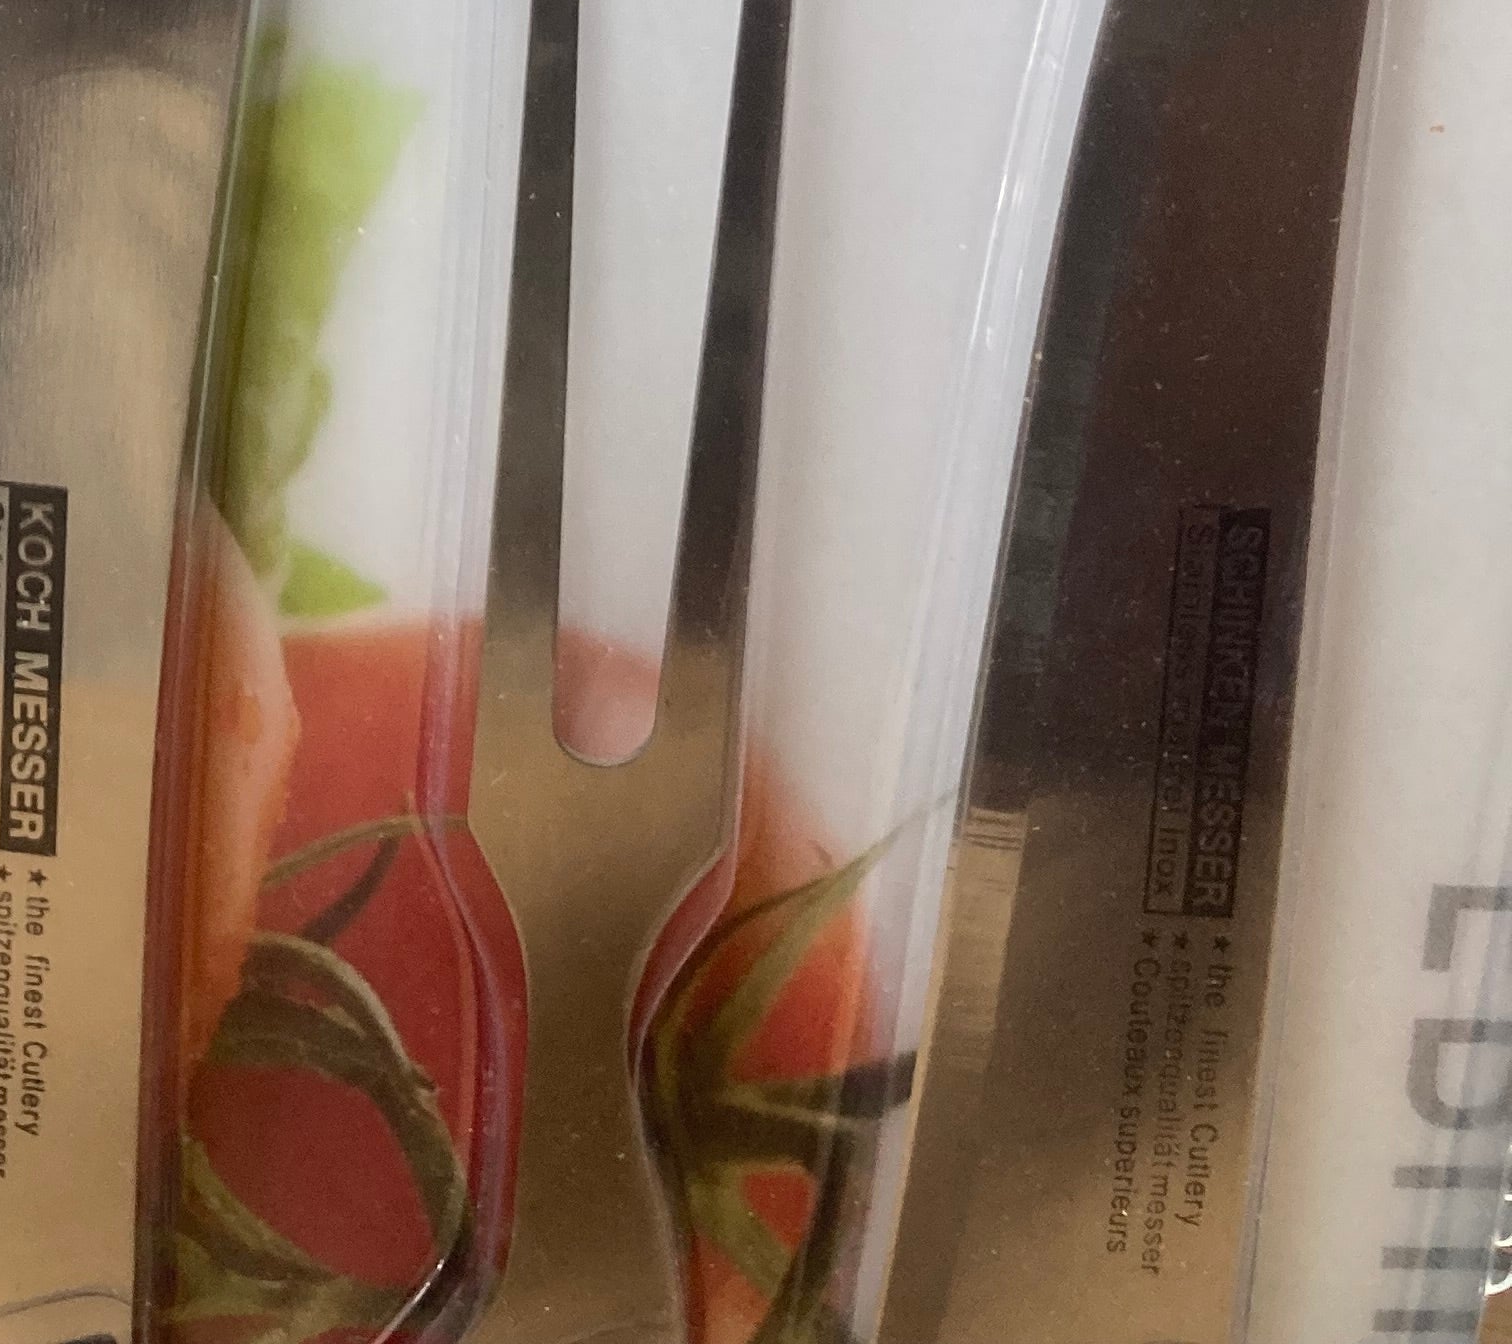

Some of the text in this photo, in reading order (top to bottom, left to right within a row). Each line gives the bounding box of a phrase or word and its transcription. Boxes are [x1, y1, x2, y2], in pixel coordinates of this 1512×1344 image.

[8, 501, 55, 842] KOCH MESSER
[14, 896, 50, 1137] the finest Cutlery
[1106, 958, 1161, 1254] Couteaux superieurs
[1175, 962, 1234, 1227] the finest Cutlery
